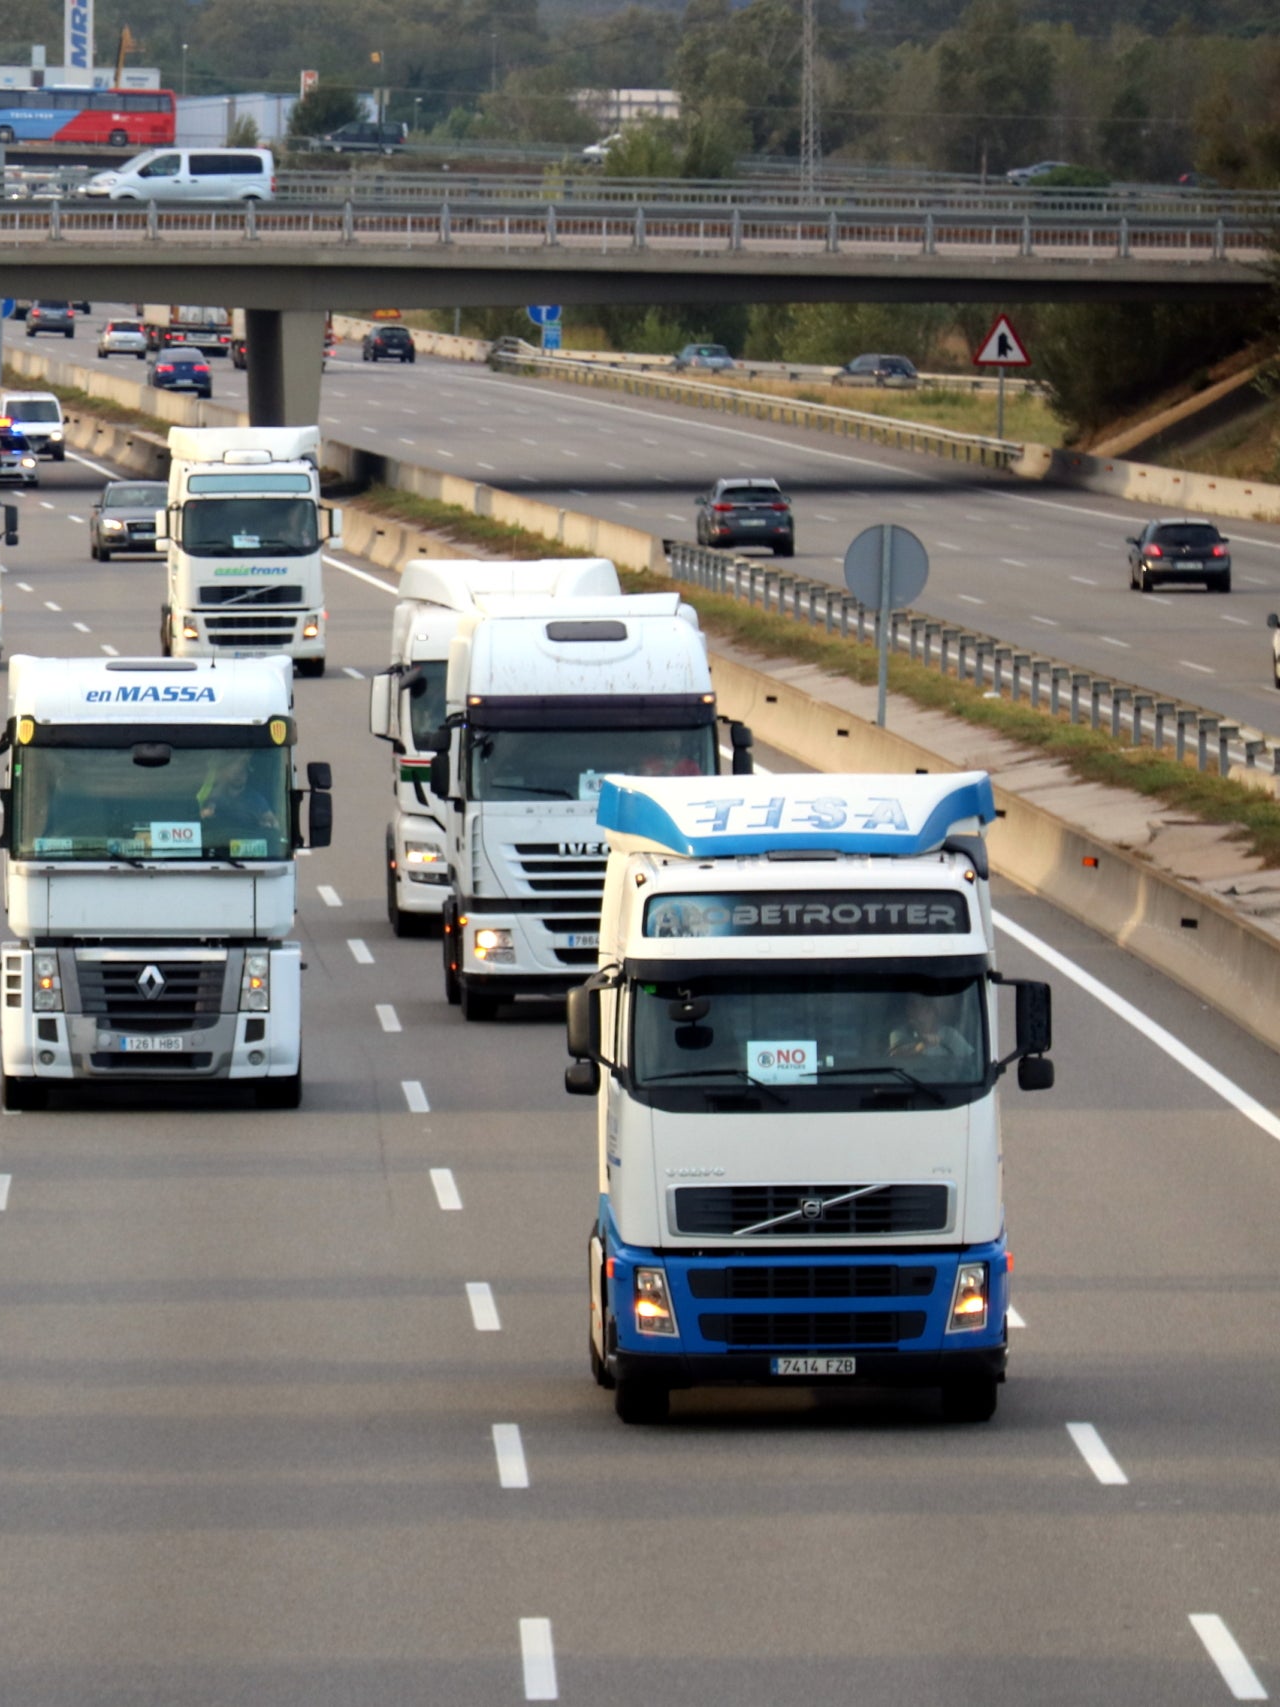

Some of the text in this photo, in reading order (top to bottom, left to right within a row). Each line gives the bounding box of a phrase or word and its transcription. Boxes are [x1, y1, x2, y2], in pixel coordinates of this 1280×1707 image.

[86, 686, 216, 702] en MASSA
[692, 797, 910, 832] TISA
[172, 828, 193, 840] NO
[776, 1049, 807, 1064] NO
[783, 1360, 854, 1373] 7414 FZB
